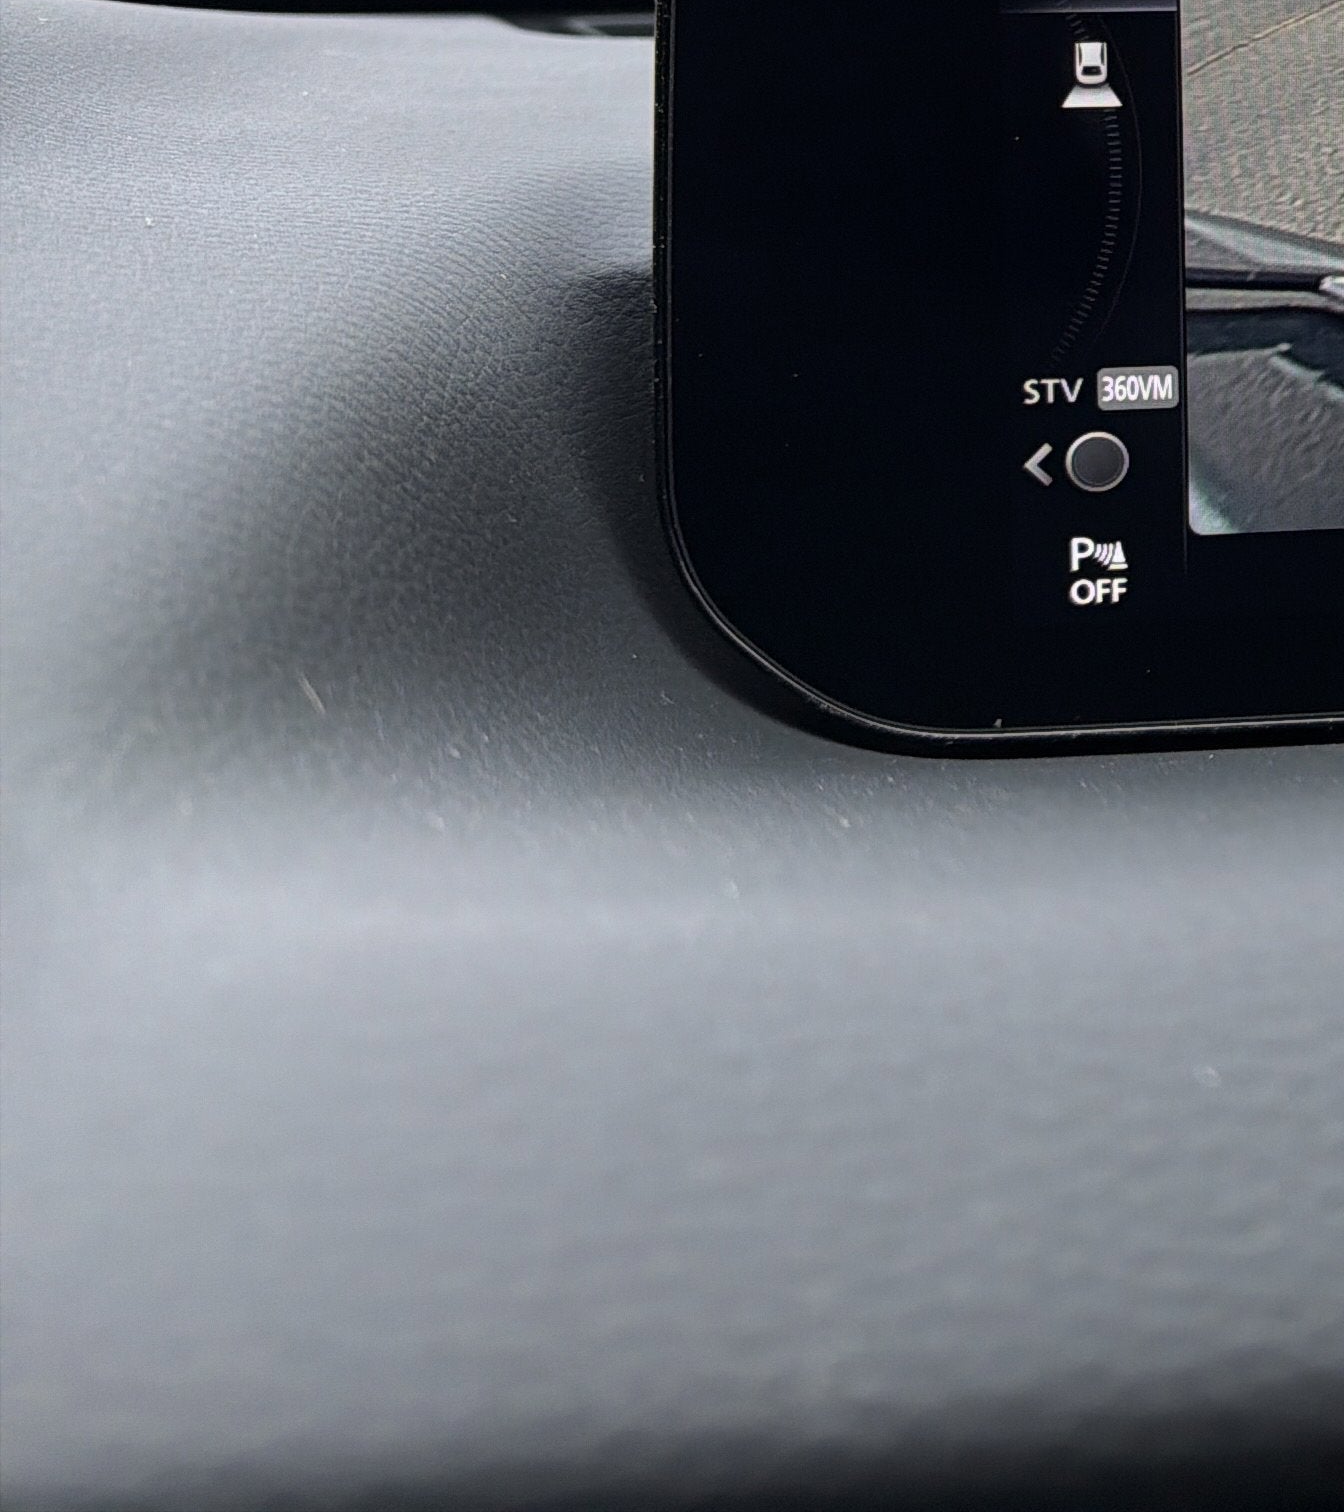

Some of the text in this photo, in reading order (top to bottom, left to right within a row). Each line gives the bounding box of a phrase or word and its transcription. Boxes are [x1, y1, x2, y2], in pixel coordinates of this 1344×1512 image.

[1023, 373, 1173, 404] STV 360VM
[1069, 577, 1129, 606] OFF
